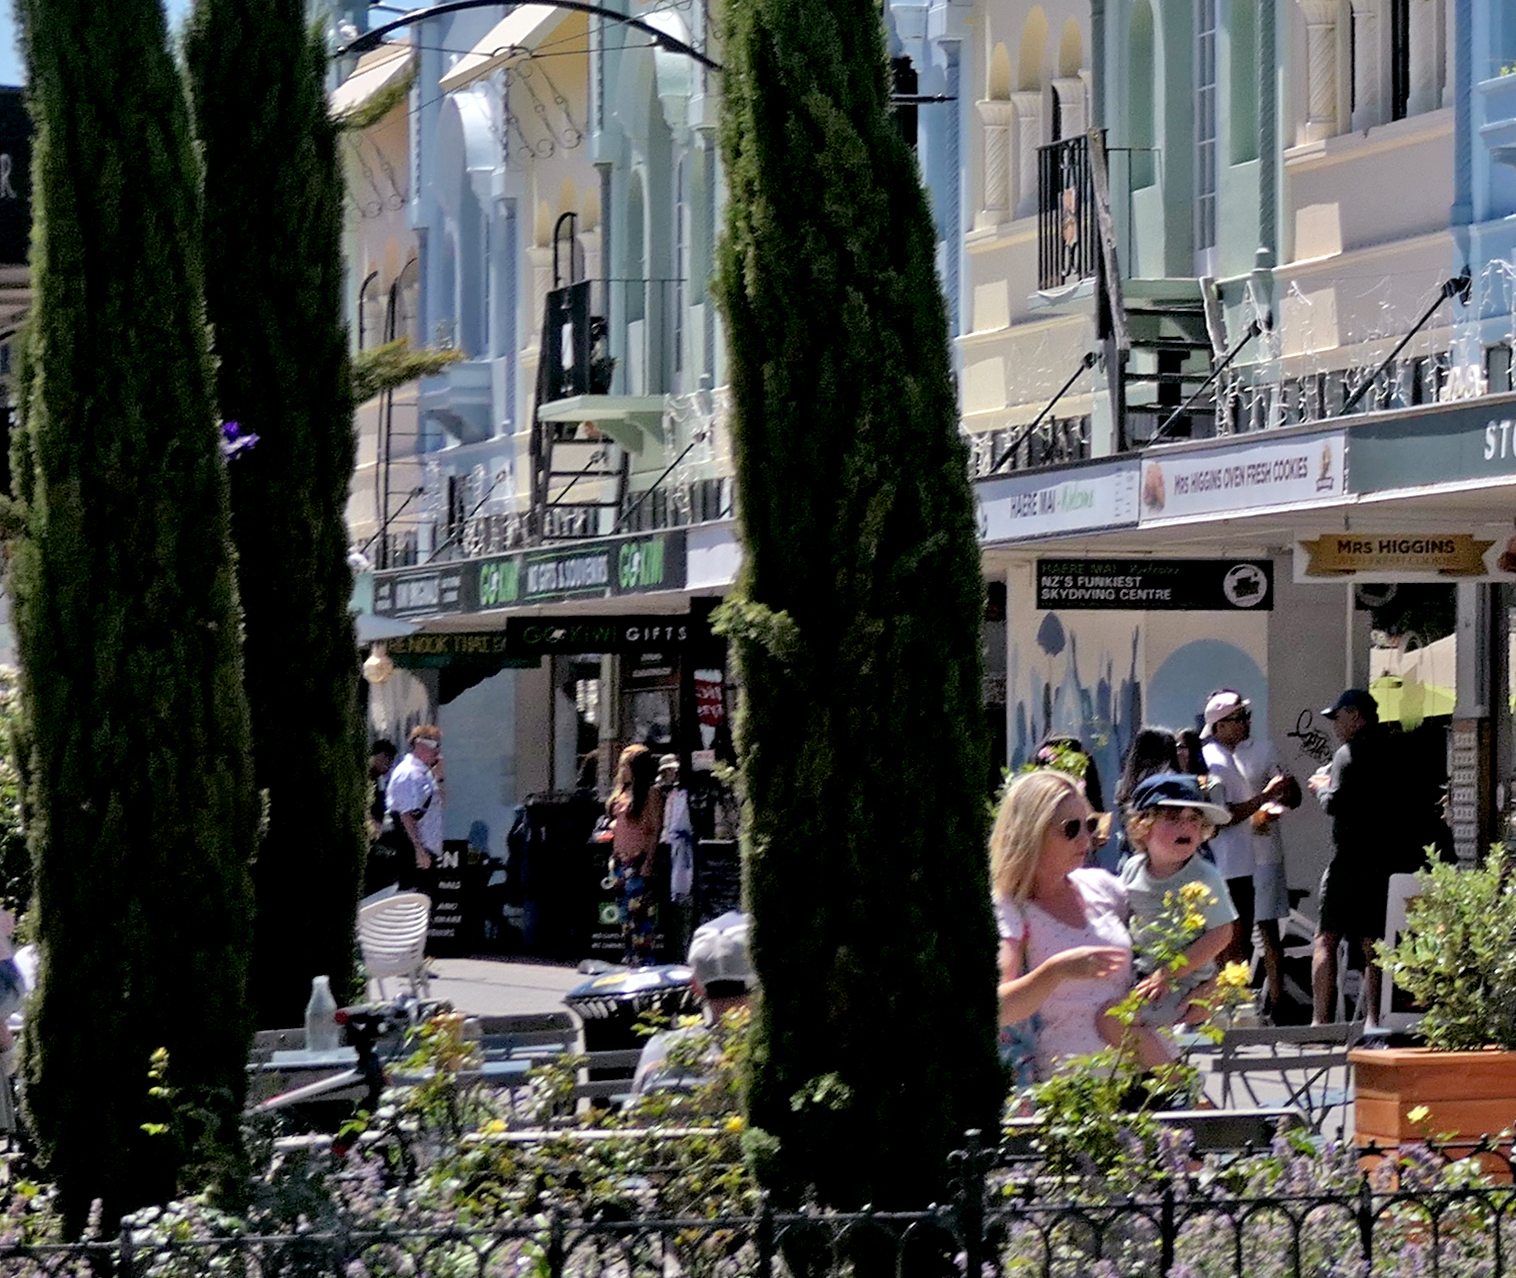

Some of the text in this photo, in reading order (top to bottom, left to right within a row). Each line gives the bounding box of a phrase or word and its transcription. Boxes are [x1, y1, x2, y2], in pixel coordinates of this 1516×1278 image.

[1379, 539, 1456, 554] HIGGINS
[1077, 575, 1142, 588] FUNKIEST
[1040, 588, 1172, 601] SKYDIVING CENTRE
[625, 626, 688, 642] GIFTS
